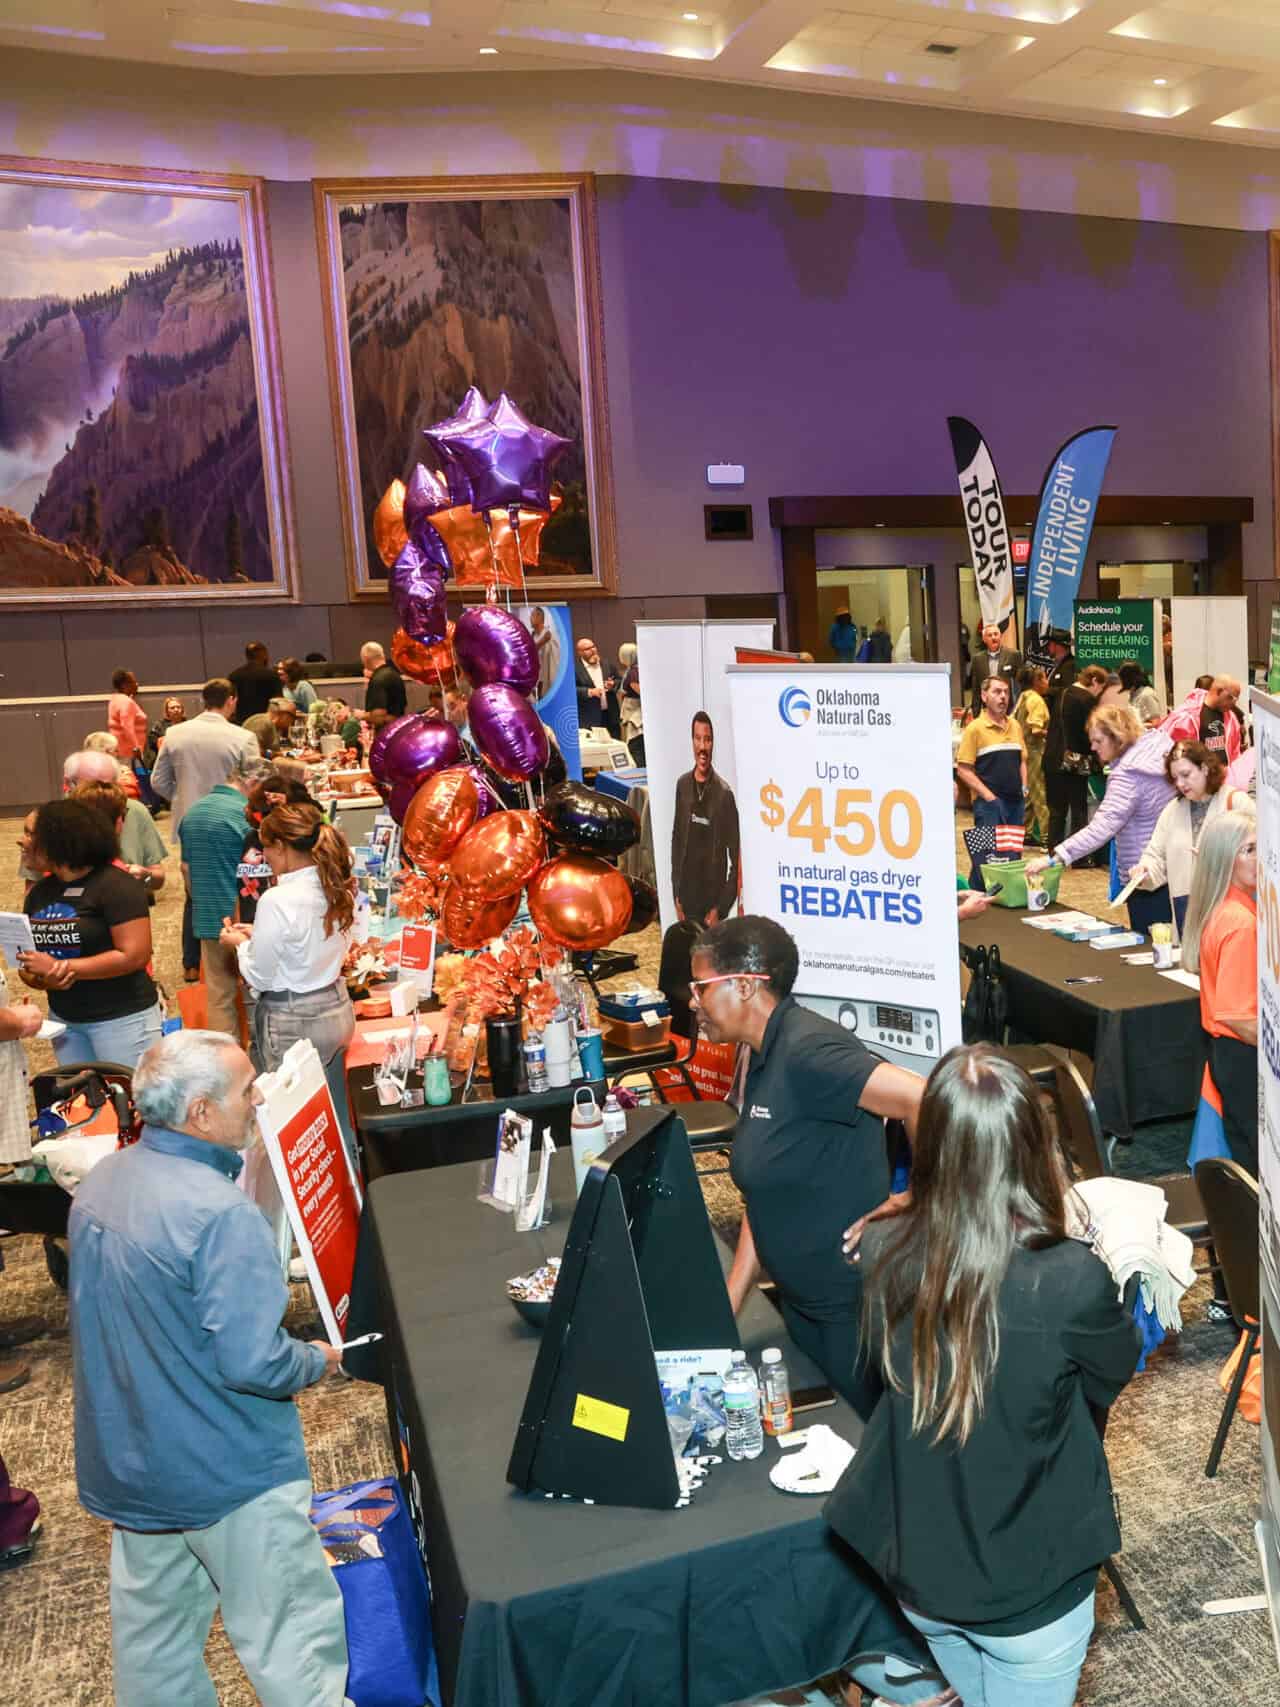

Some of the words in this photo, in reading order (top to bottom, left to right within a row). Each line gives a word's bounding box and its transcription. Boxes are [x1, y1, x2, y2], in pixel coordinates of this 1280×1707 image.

[963, 475, 996, 591] TODAY
[981, 479, 1007, 577] TOUR
[1032, 461, 1076, 598] INDEPENDENT
[1056, 495, 1091, 577] LIVING
[1078, 606, 1114, 614] AudioNova
[1078, 621, 1121, 632] Schedule
[1122, 623, 1144, 634] your
[1078, 634, 1103, 646] FREE
[1105, 635, 1150, 646] HEARING
[1078, 648, 1139, 659] SCREENING!
[816, 688, 880, 706] Oklahoma
[816, 708, 864, 726] Natural
[866, 708, 892, 726] Gas
[816, 760, 840, 784] Up
[843, 763, 860, 781] to
[760, 777, 923, 860] $450
[778, 861, 791, 878] in
[793, 863, 846, 882] natural
[849, 871, 879, 887] gas
[881, 869, 922, 890] dryer
[780, 883, 923, 926] REBATES
[32, 932, 81, 944] DICARE
[48, 922, 77, 932] ABOUT
[299, 1156, 311, 1181] your
[310, 1135, 327, 1162] Social
[296, 1168, 320, 1201] Security
